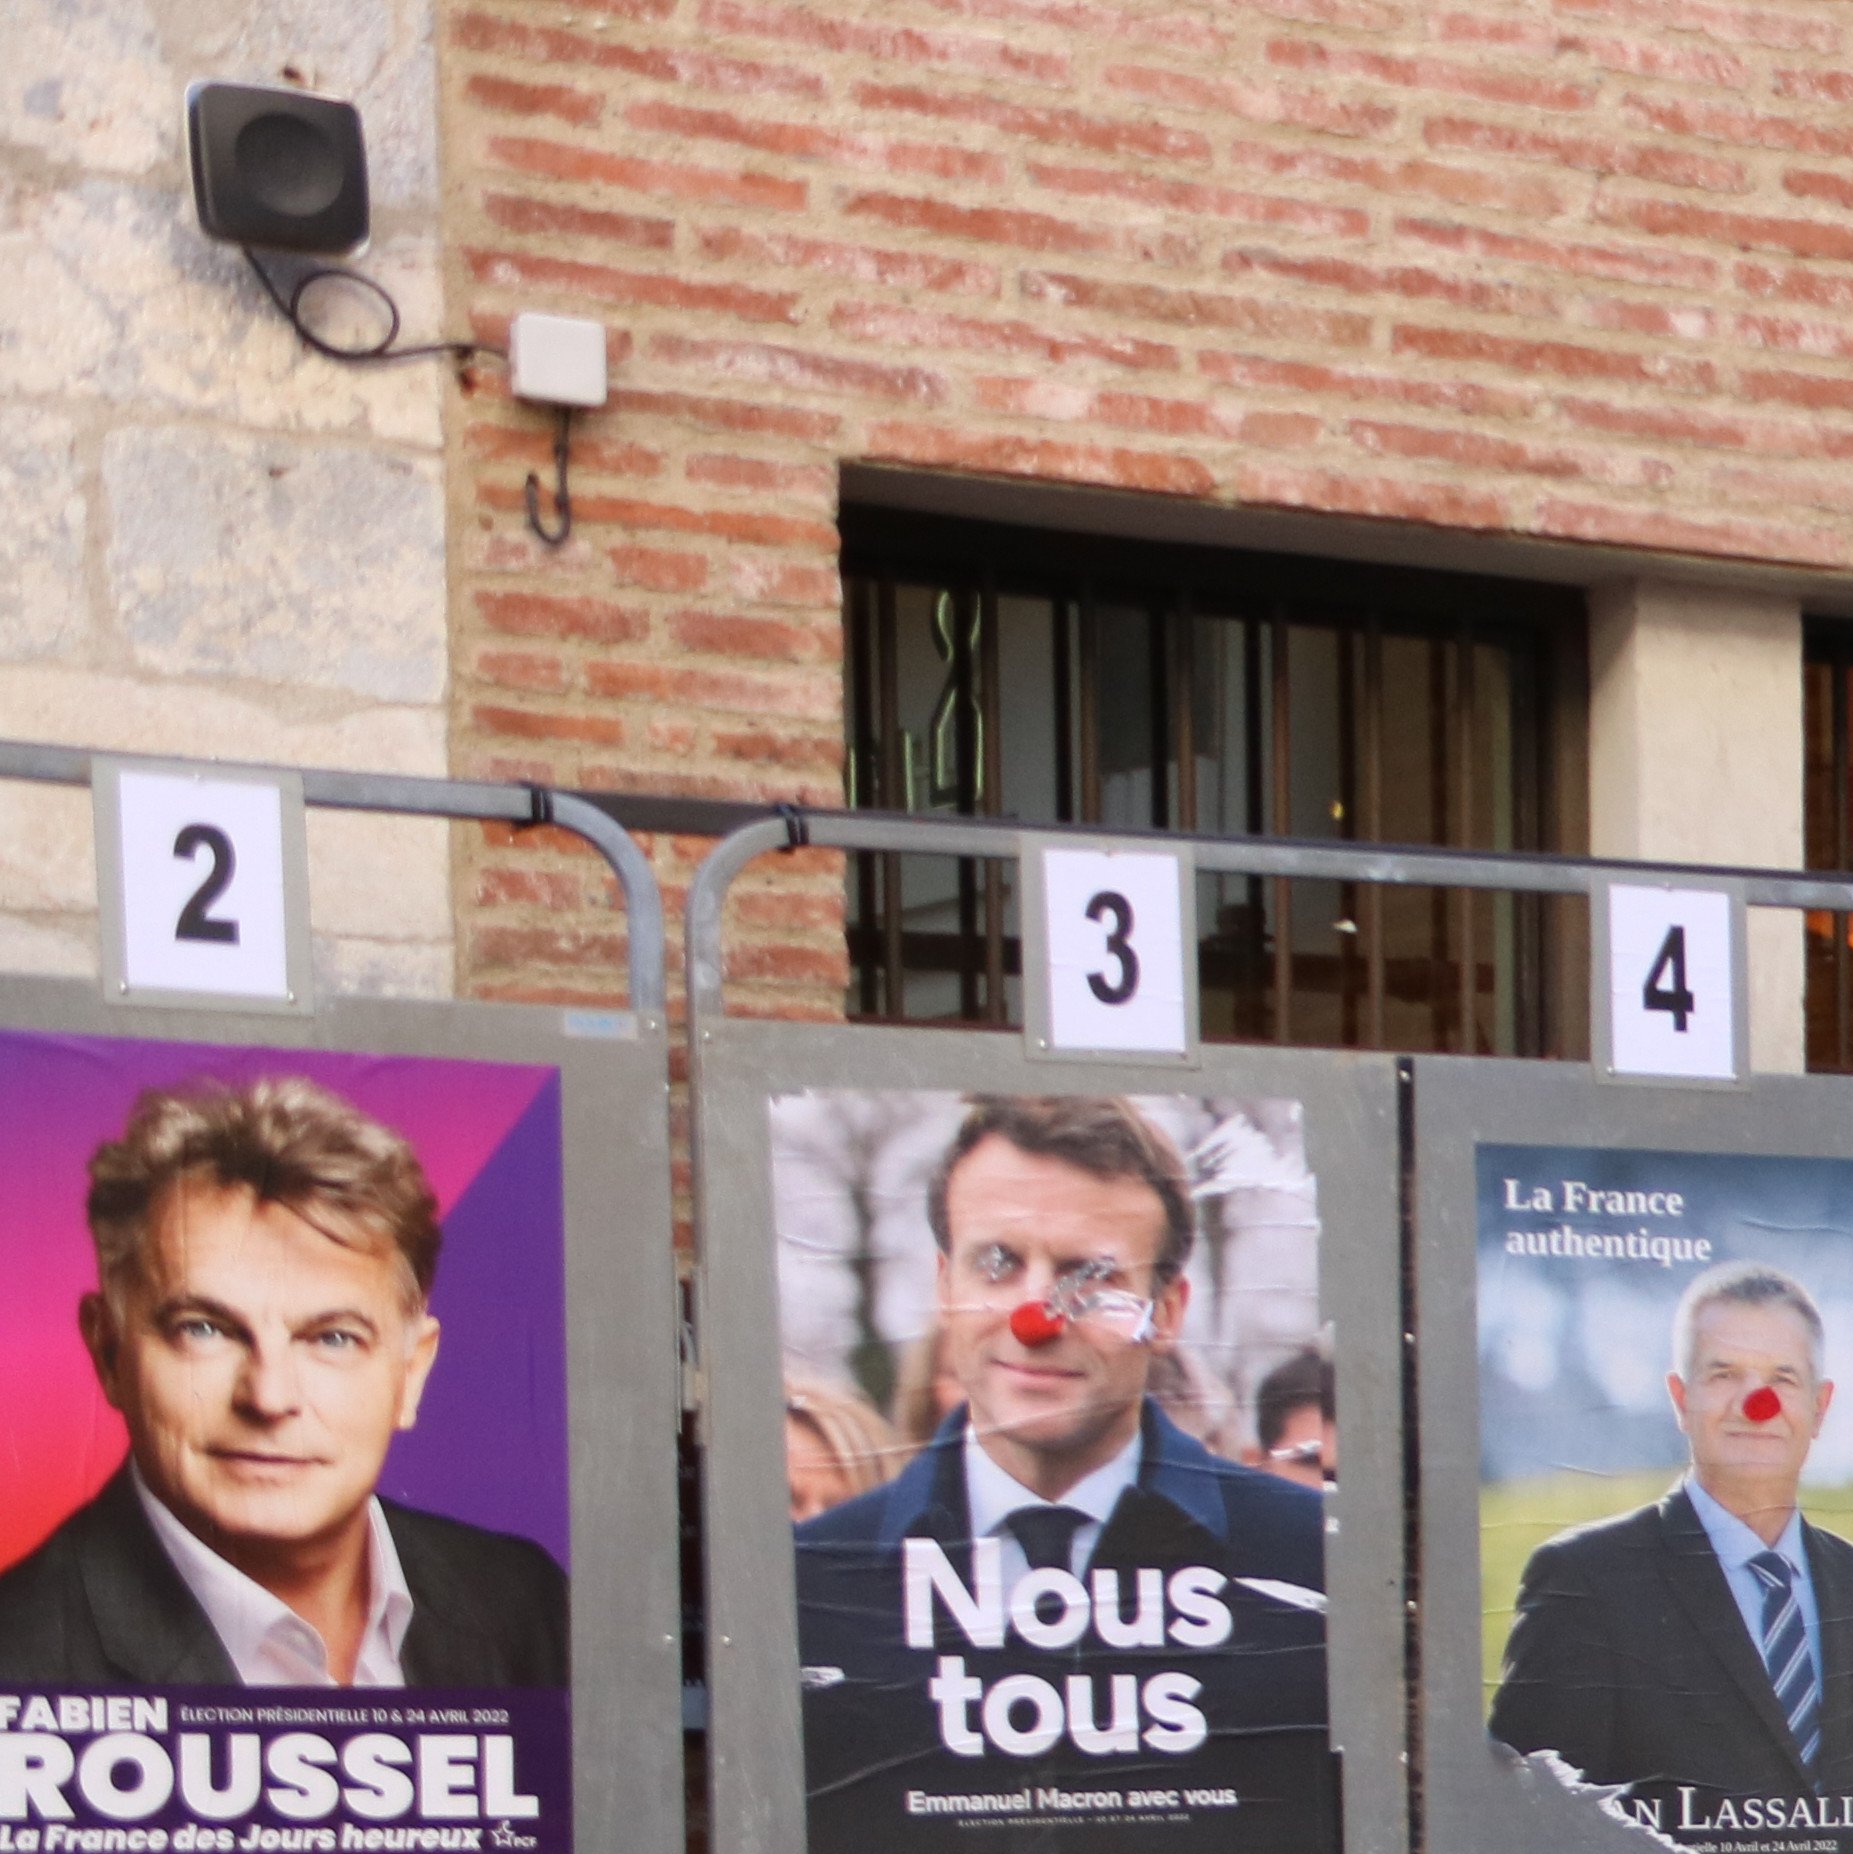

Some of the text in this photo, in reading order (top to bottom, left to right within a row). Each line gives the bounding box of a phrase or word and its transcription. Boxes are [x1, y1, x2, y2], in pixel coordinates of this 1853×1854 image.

[173, 823, 241, 946] 2
[1085, 891, 1140, 1005] 3
[1643, 925, 1694, 1032] 4
[1504, 1179, 1684, 1218] La France
[1504, 1225, 1712, 1268] authentique
[903, 1537, 1234, 1649] Nous
[0, 1695, 168, 1733] FABIEN
[180, 1706, 253, 1722] ÉLECTION
[257, 1707, 368, 1723] PRÉSIDENTIELLE
[373, 1709, 387, 1722] 10
[407, 1709, 425, 1723] 24
[430, 1709, 469, 1723] AVRIL
[473, 1709, 509, 1723] 2022
[929, 1656, 1208, 1756] tous
[0, 1732, 540, 1821] ROUSSEL
[908, 1788, 1237, 1814] Emmanuel Macron avec vous
[0, 1822, 483, 1851] La France des Jours heureux
[1720, 1842, 1732, 1852] 10
[1734, 1840, 1758, 1853] Avril
[1760, 1843, 1771, 1852] et
[1772, 1841, 1785, 1852] 24
[1786, 1840, 1811, 1852] Avril
[1812, 1840, 1837, 1852] 2022
